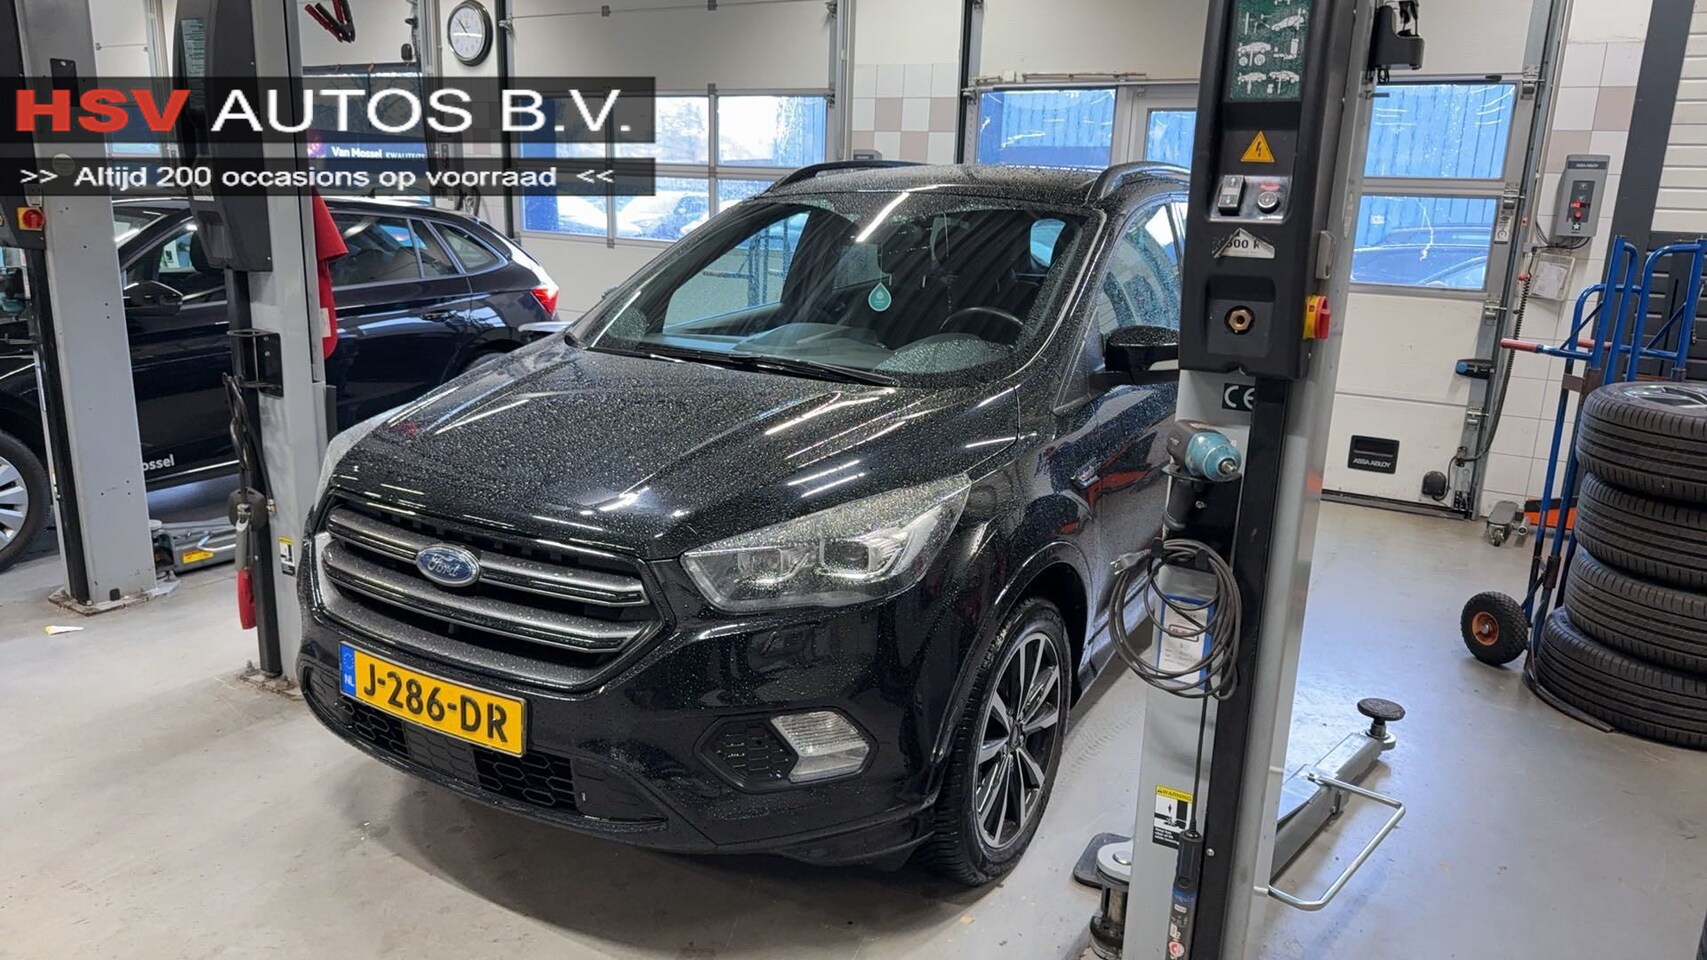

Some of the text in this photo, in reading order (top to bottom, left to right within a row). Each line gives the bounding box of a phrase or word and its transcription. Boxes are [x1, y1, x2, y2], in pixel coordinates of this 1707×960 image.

[331, 146, 350, 158] Van
[351, 147, 383, 159] Mossel
[142, 453, 175, 471] ossel
[427, 553, 460, 577] Ford
[344, 673, 355, 687] NL
[363, 663, 508, 743] J-286-DR
